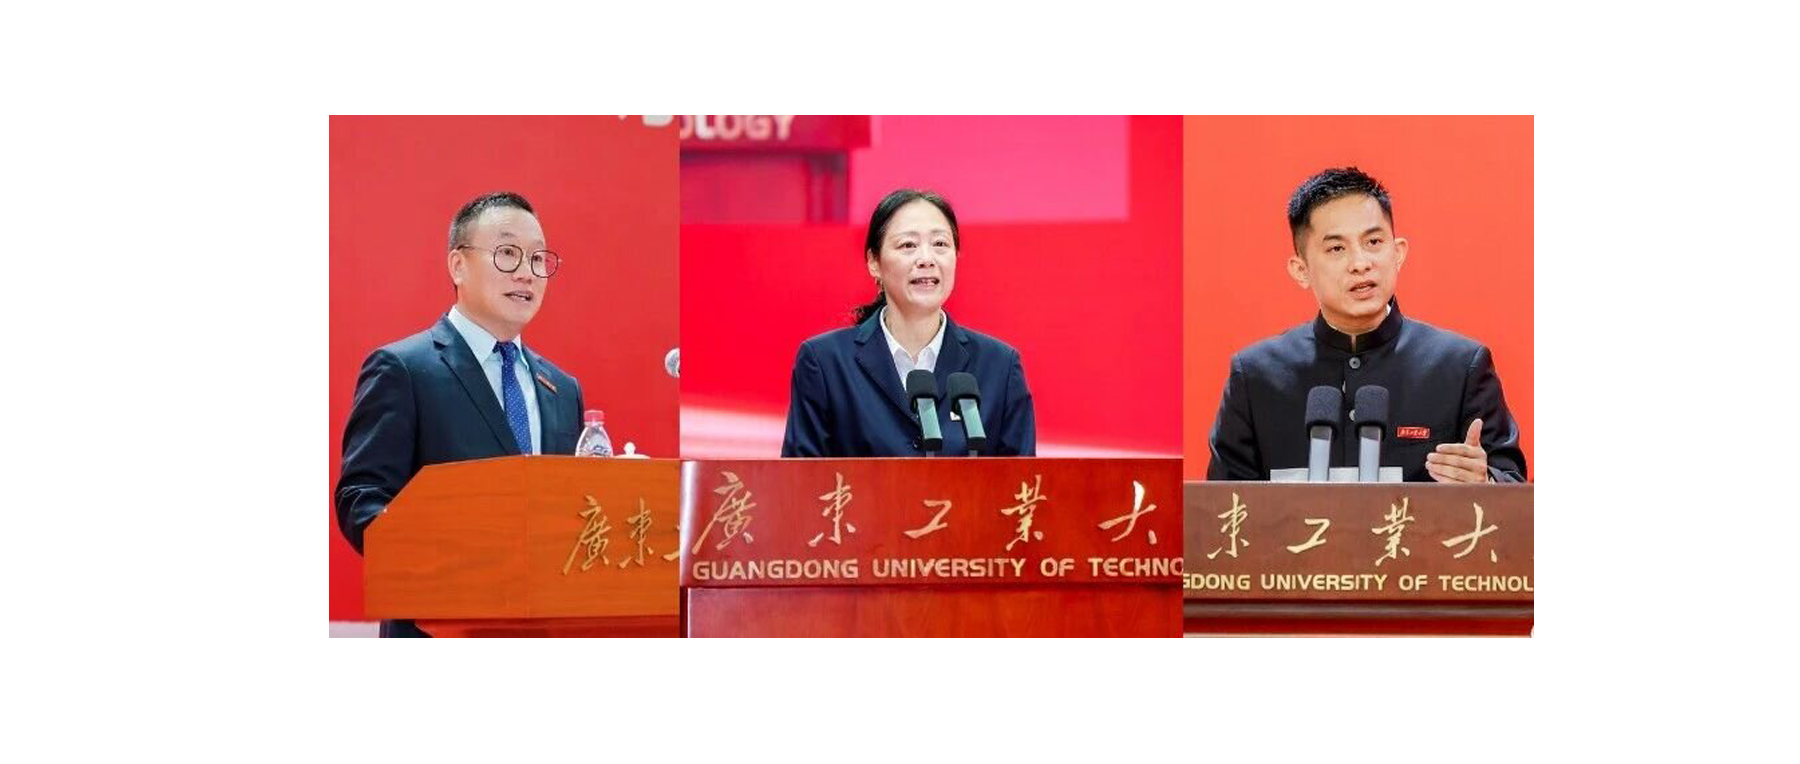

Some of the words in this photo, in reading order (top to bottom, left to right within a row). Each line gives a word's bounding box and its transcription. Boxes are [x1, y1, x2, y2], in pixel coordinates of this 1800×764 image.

[563, 495, 680, 575] 廣東
[692, 559, 859, 580] GUANGDONG
[872, 558, 1025, 578] UNIVERSITY
[1040, 558, 1074, 577] OF
[1088, 558, 1183, 577] TECHNO
[1260, 573, 1387, 591] UNIVERSITY
[1399, 574, 1427, 591] OF
[1438, 575, 1534, 592] TECHNOL
